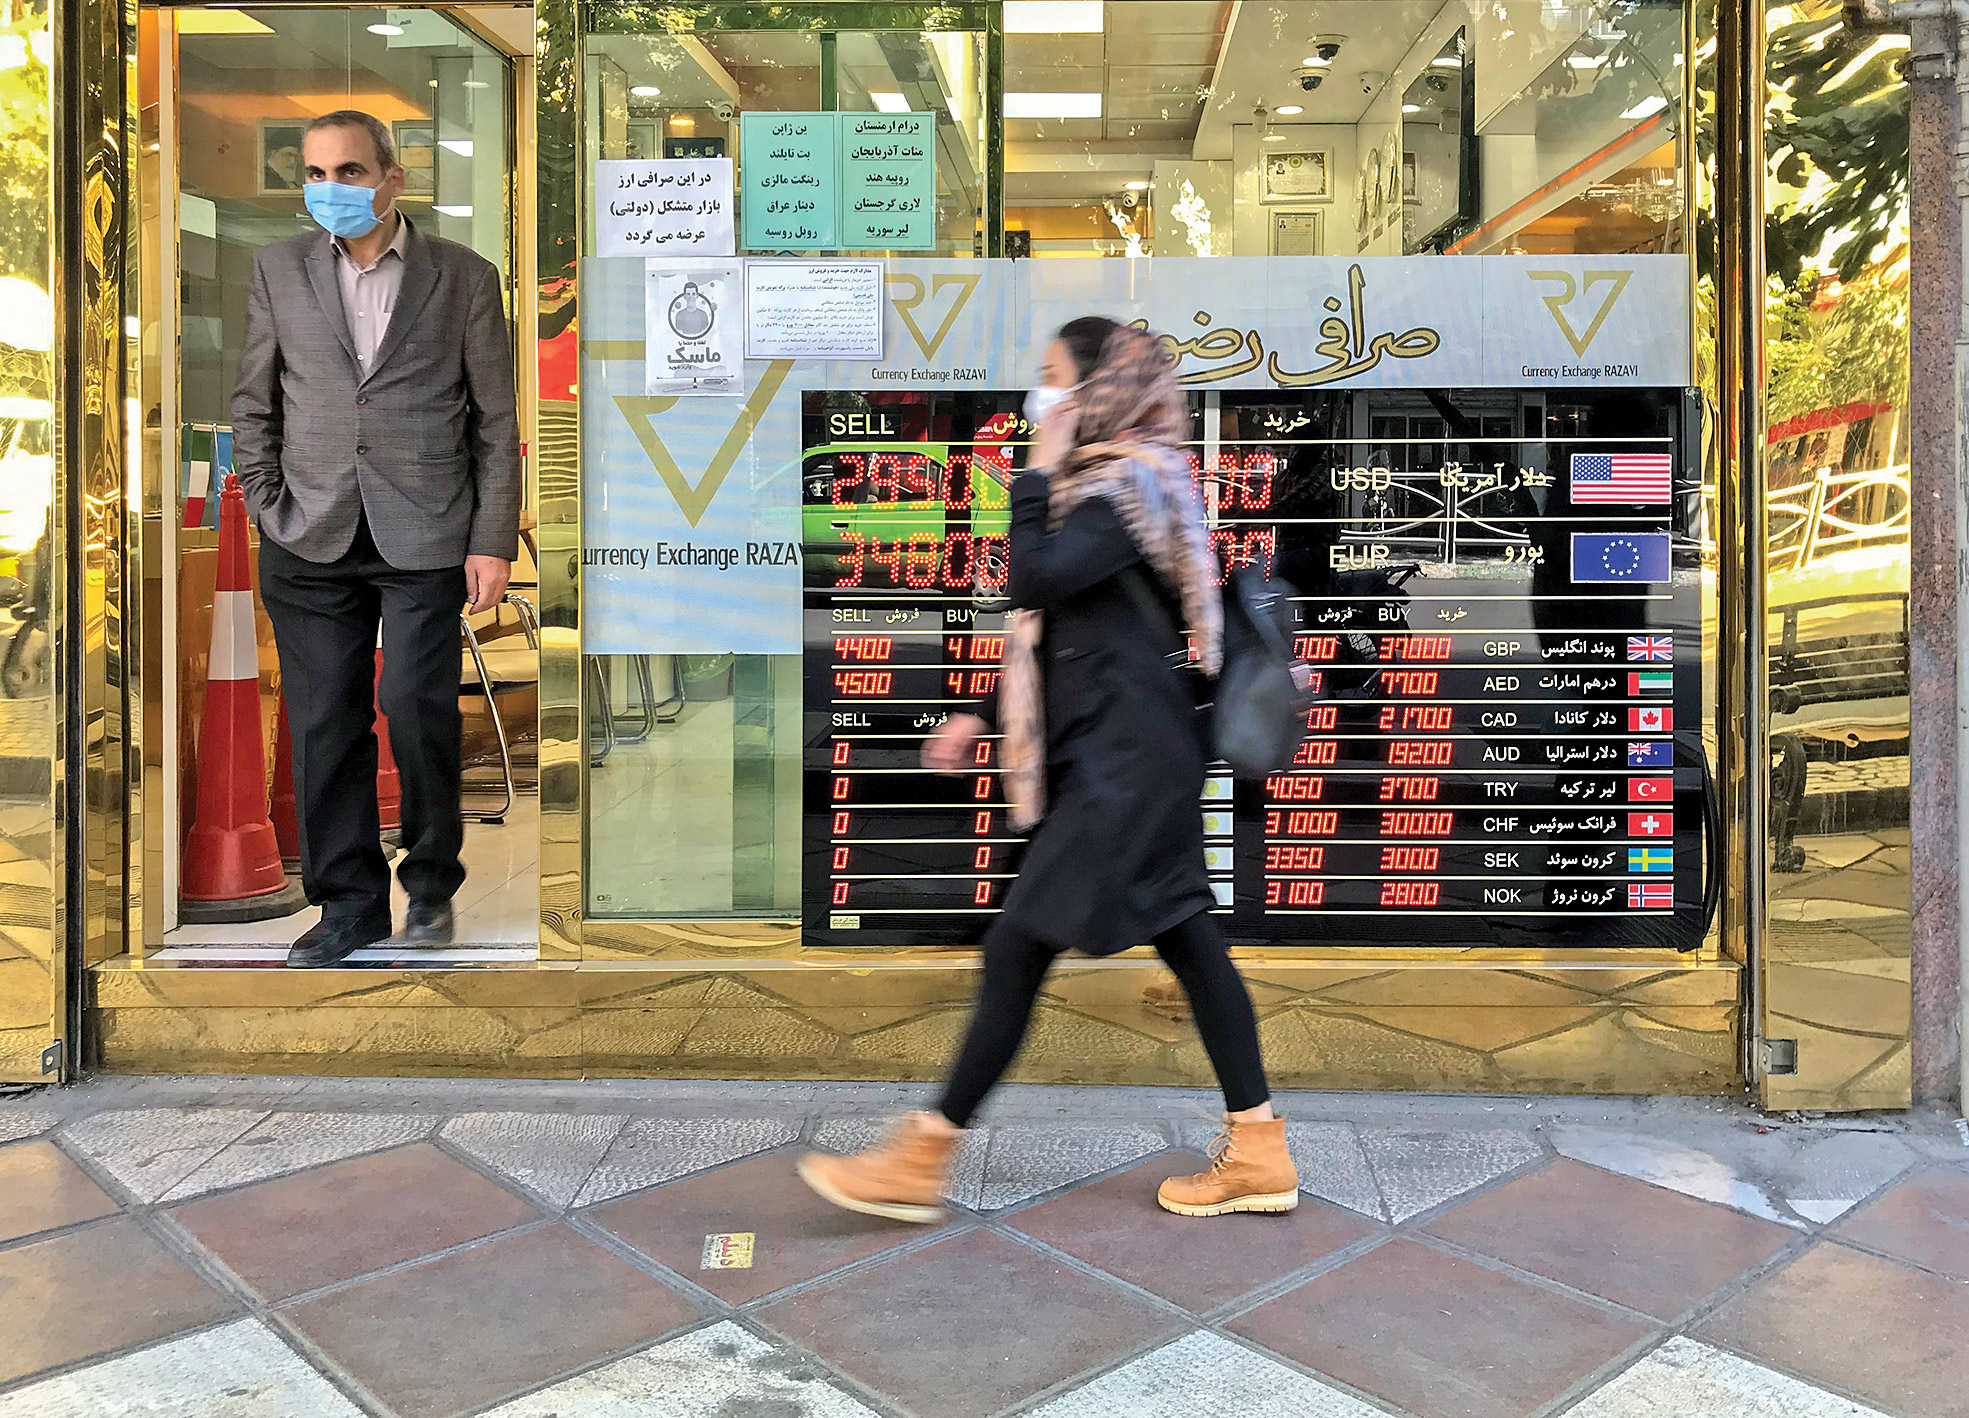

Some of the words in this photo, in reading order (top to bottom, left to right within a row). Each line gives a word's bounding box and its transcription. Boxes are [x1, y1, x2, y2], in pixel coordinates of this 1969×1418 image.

[772, 123, 792, 136] ژاپن
[795, 124, 807, 136] ین
[855, 120, 896, 134] ارمنستان
[898, 120, 919, 133] درام
[770, 148, 794, 161] تایلند
[797, 150, 810, 161] بت
[852, 145, 898, 160] آذربایجان
[902, 146, 924, 156] منات
[618, 172, 634, 188] ارز
[638, 171, 674, 187] صرافی
[677, 171, 695, 186] این
[698, 173, 711, 187] در
[761, 174, 788, 187] مالزی
[866, 173, 883, 183] هند
[886, 174, 909, 186] روپیه
[610, 200, 654, 216] (دولتی)
[658, 200, 693, 215] متشکل
[696, 199, 720, 215] بازار
[767, 200, 790, 213] عراق
[793, 200, 815, 213] دینار
[854, 198, 896, 211] گرجستان
[899, 198, 921, 211] لاری
[626, 229, 653, 244] گردد
[656, 232, 673, 244] می
[676, 228, 705, 244] عرضه
[765, 228, 792, 239] روسیه
[794, 226, 818, 239] روبل
[866, 225, 894, 237] سوریه
[897, 223, 909, 237] لیر
[1268, 264, 1440, 388] صرافی
[667, 346, 721, 364] ماسک
[1128, 310, 1264, 385] رضو
[871, 368, 909, 382] Currency
[911, 368, 951, 383] Exchange
[953, 368, 987, 380] RAZAVI
[1522, 364, 1560, 380] Currency
[1562, 365, 1602, 380] Exchange
[1604, 365, 1638, 377] RAZAVI
[830, 414, 895, 436] SELL
[993, 412, 1040, 436] روش
[1264, 411, 1311, 438] خرید
[831, 454, 1011, 511] 29500
[1331, 466, 1392, 491] USD
[1440, 462, 1505, 493] آمریکا
[1508, 466, 1548, 492] دلار
[582, 547, 650, 570] urrency
[656, 542, 739, 570] Exchange
[746, 542, 804, 566] RAZA
[834, 531, 1011, 588] 34800
[1330, 544, 1390, 569] EUR
[1504, 544, 1546, 565] یورو
[832, 609, 871, 623] SELL
[885, 608, 920, 624] فروش
[946, 609, 979, 623] BUY
[1318, 606, 1353, 622] فروش
[1378, 607, 1412, 622] BUY
[1436, 606, 1468, 622] خرید
[834, 636, 892, 660] 4400
[948, 636, 1006, 660] 4100
[1378, 636, 1453, 660] 37000
[1483, 641, 1521, 656] GBP
[1541, 638, 1587, 658] انگلیس
[1590, 641, 1616, 658] پوند
[834, 671, 892, 695] 4500
[1380, 672, 1438, 695] 7700
[1483, 676, 1520, 692] AED
[1538, 674, 1580, 691] امارات
[1583, 678, 1617, 694] درهم
[832, 712, 872, 727] SELL
[914, 712, 948, 728] فروش
[1379, 706, 1453, 730] 21700
[1481, 712, 1518, 727] CAD
[1554, 710, 1590, 724] کانادا
[1592, 711, 1617, 728] دلار
[833, 741, 850, 764] 0
[974, 741, 991, 764] 0
[1388, 742, 1453, 764] 19200
[1482, 746, 1520, 762] AUD
[1546, 746, 1590, 763] استرالیا
[1592, 746, 1618, 762] دلار
[833, 776, 850, 798] 0
[974, 776, 991, 798] 0
[1265, 776, 1324, 800] 4050
[1380, 776, 1439, 800] 3700
[1483, 782, 1519, 797] TRY
[1560, 780, 1596, 798] ترکیه
[1598, 780, 1616, 798] لیر
[833, 812, 850, 834] 0
[974, 812, 991, 834] 0
[1265, 812, 1338, 836] 31000
[1380, 812, 1453, 836] 30000
[1483, 817, 1519, 832] CHF
[1529, 816, 1574, 834] سوئیس
[1577, 816, 1617, 834] فرانک
[833, 846, 850, 869] 0
[974, 846, 991, 869] 0
[1265, 846, 1324, 870] 3350
[1380, 846, 1439, 870] 3000
[1484, 852, 1520, 868] SEK
[1546, 852, 1578, 870] سوئد
[1581, 851, 1617, 870] کرون
[833, 882, 850, 904] 0
[974, 882, 991, 904] 0
[1265, 882, 1324, 906] 3100
[1380, 882, 1439, 906] 2800
[1484, 888, 1522, 904] NOK
[1551, 888, 1578, 906] نروژ
[1581, 887, 1616, 906] کرون
